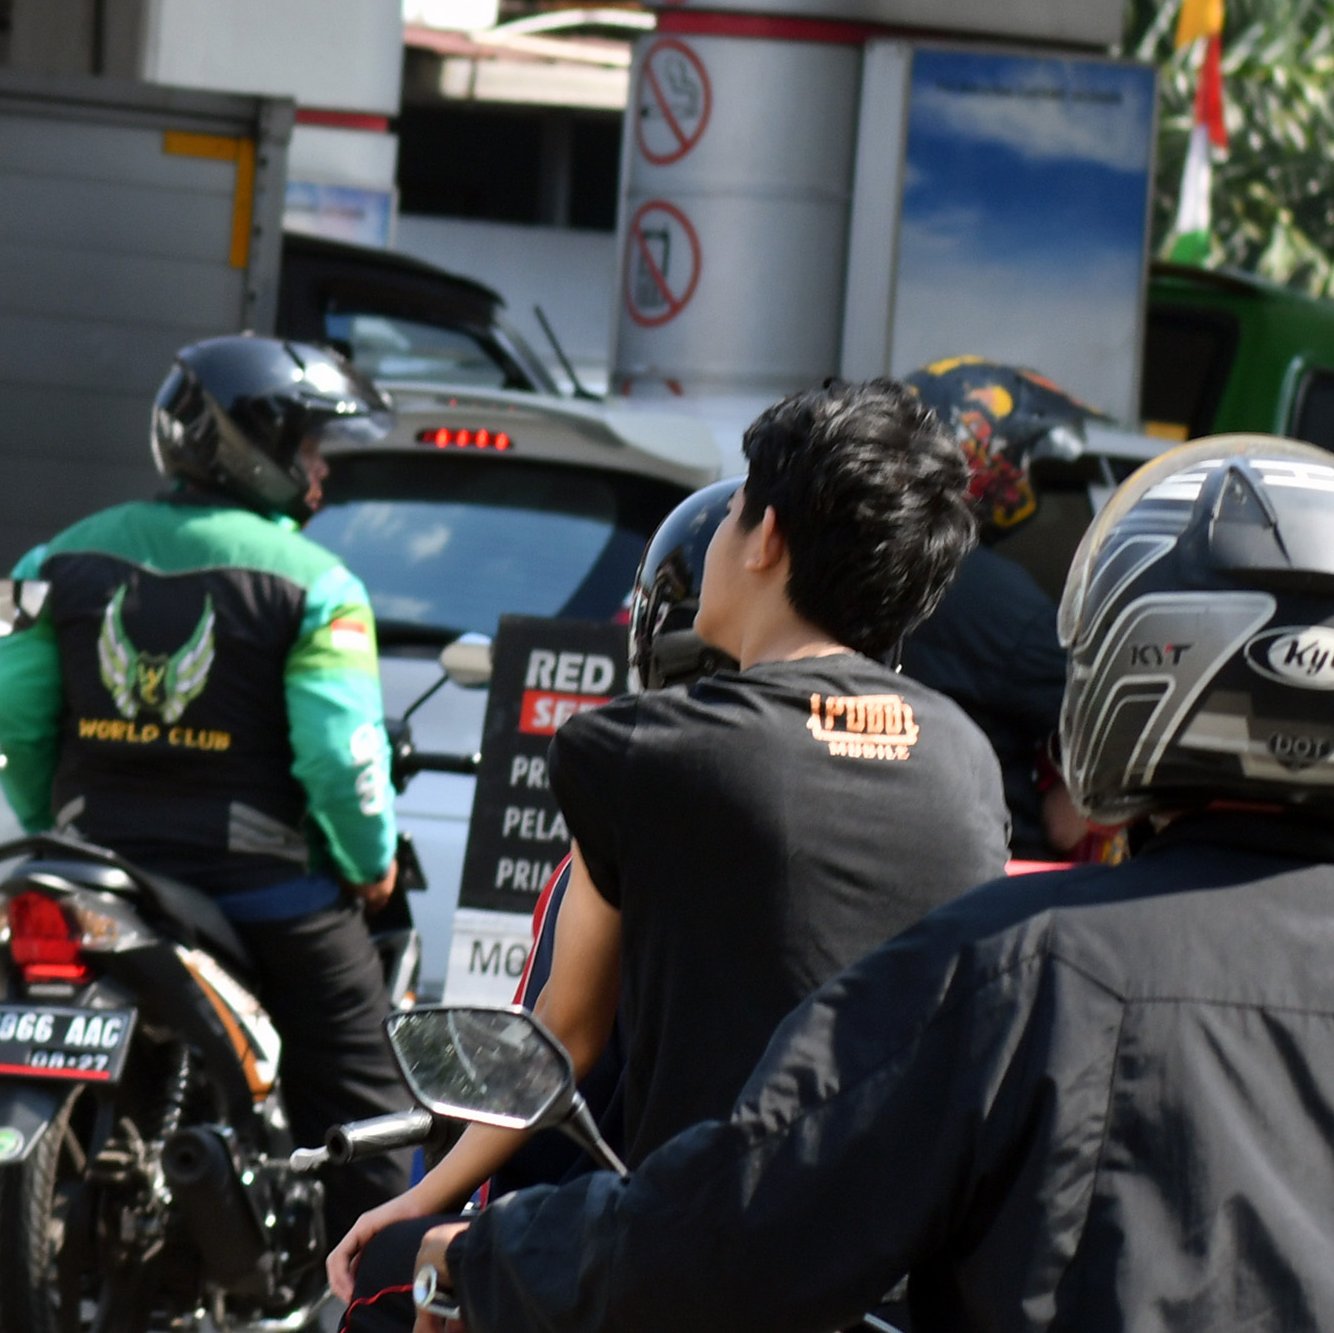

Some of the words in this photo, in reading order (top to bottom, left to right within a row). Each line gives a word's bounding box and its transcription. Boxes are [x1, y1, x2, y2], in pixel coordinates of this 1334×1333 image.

[1130, 642, 1192, 666] KYT
[525, 649, 615, 695] RED
[79, 718, 160, 744] WORLD
[168, 726, 231, 752] CLUB
[64, 1015, 122, 1049] AAC
